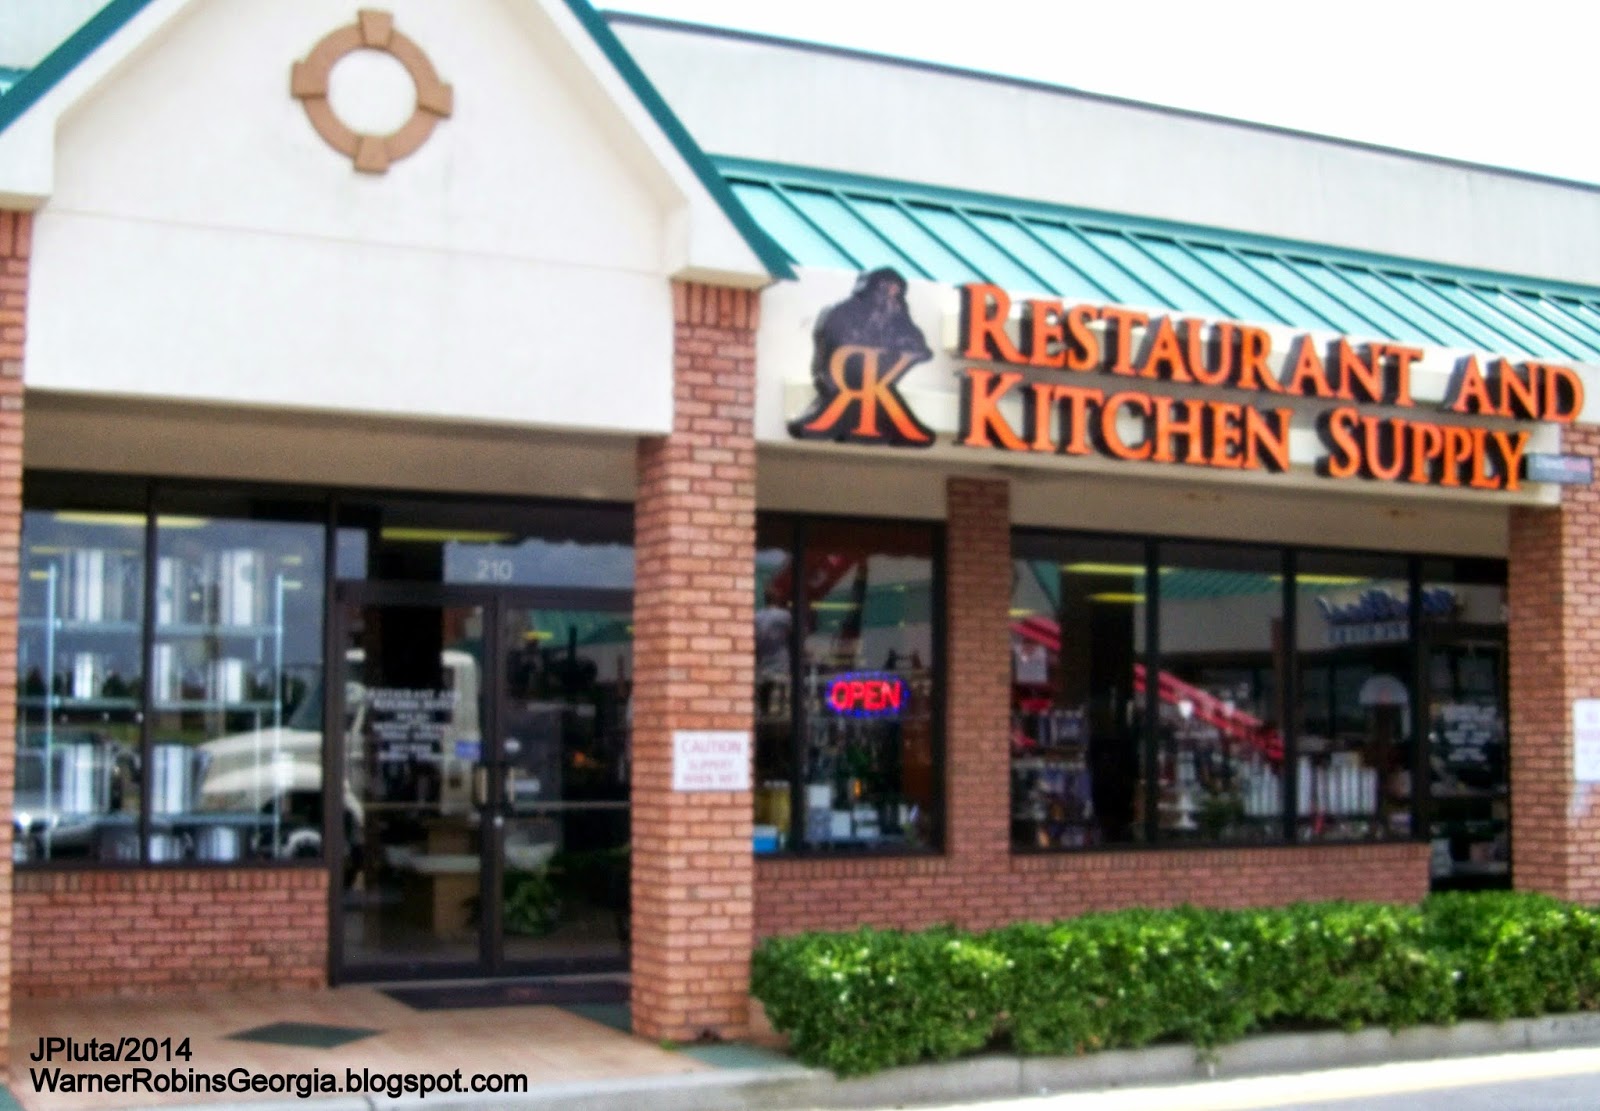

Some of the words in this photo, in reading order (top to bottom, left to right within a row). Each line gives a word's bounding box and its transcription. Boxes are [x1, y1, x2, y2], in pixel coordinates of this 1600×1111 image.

[962, 283, 1424, 407] RESTAURANT
[1453, 354, 1585, 423] AND
[964, 368, 1294, 472] KITCHEN
[1328, 407, 1531, 492] SUPPLY
[476, 559, 513, 580] 210
[831, 680, 902, 711] OPEN
[681, 739, 742, 753] CAUTION
